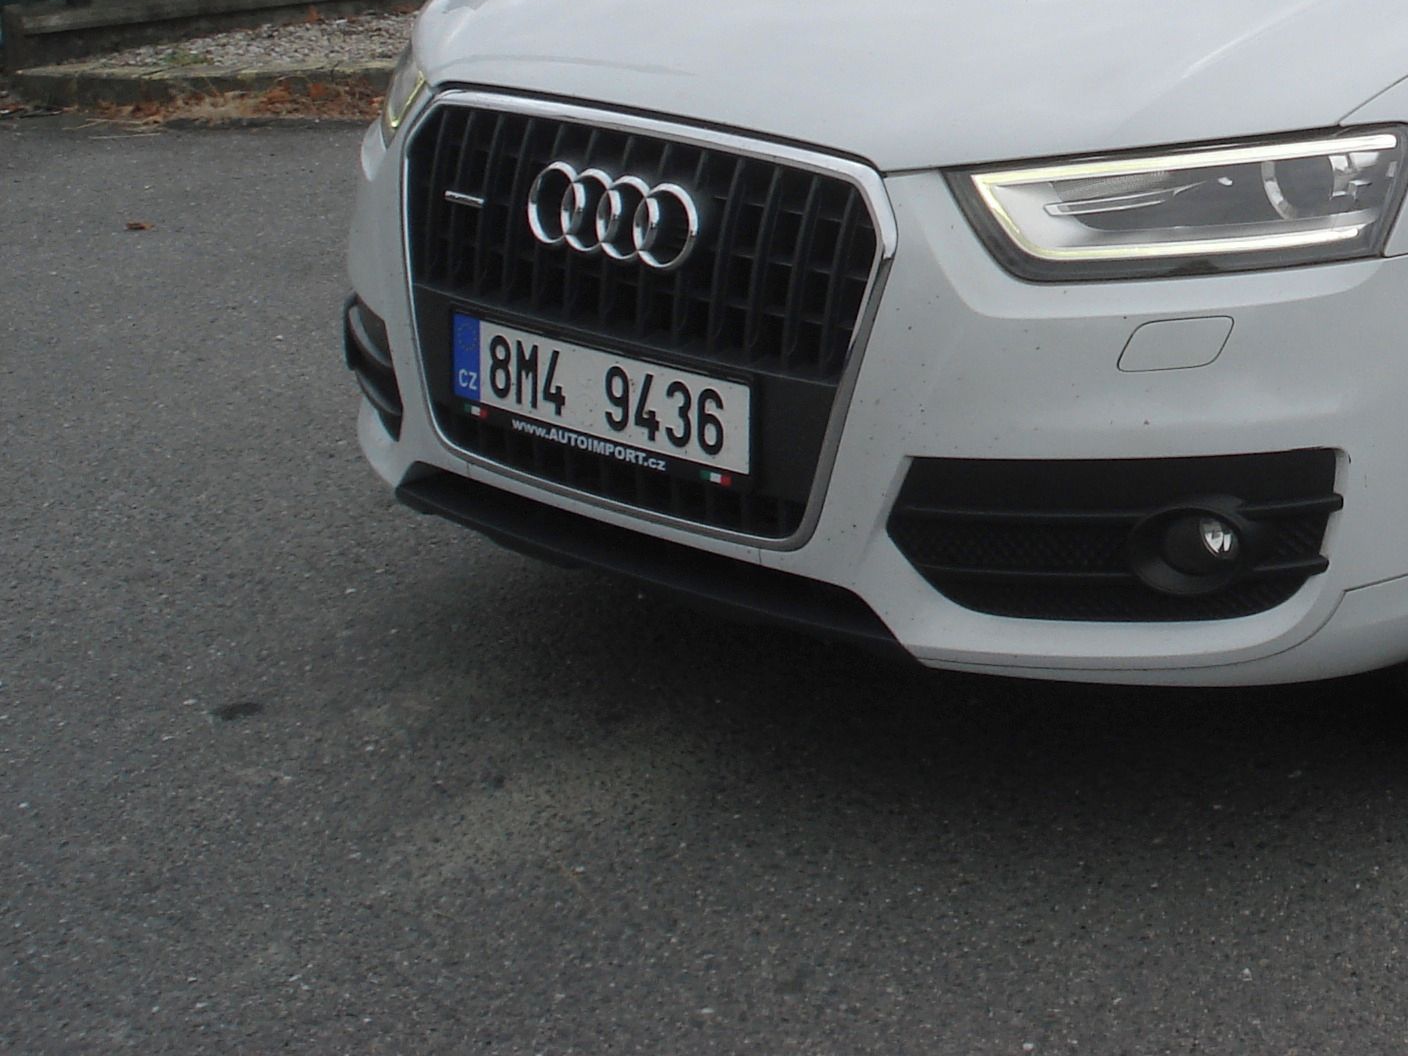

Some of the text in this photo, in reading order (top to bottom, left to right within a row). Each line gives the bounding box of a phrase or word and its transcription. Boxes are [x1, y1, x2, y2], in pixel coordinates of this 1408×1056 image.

[458, 334, 725, 456] CZ 8M4 9436
[511, 417, 667, 472] www.AUTOIMPORT.cz
